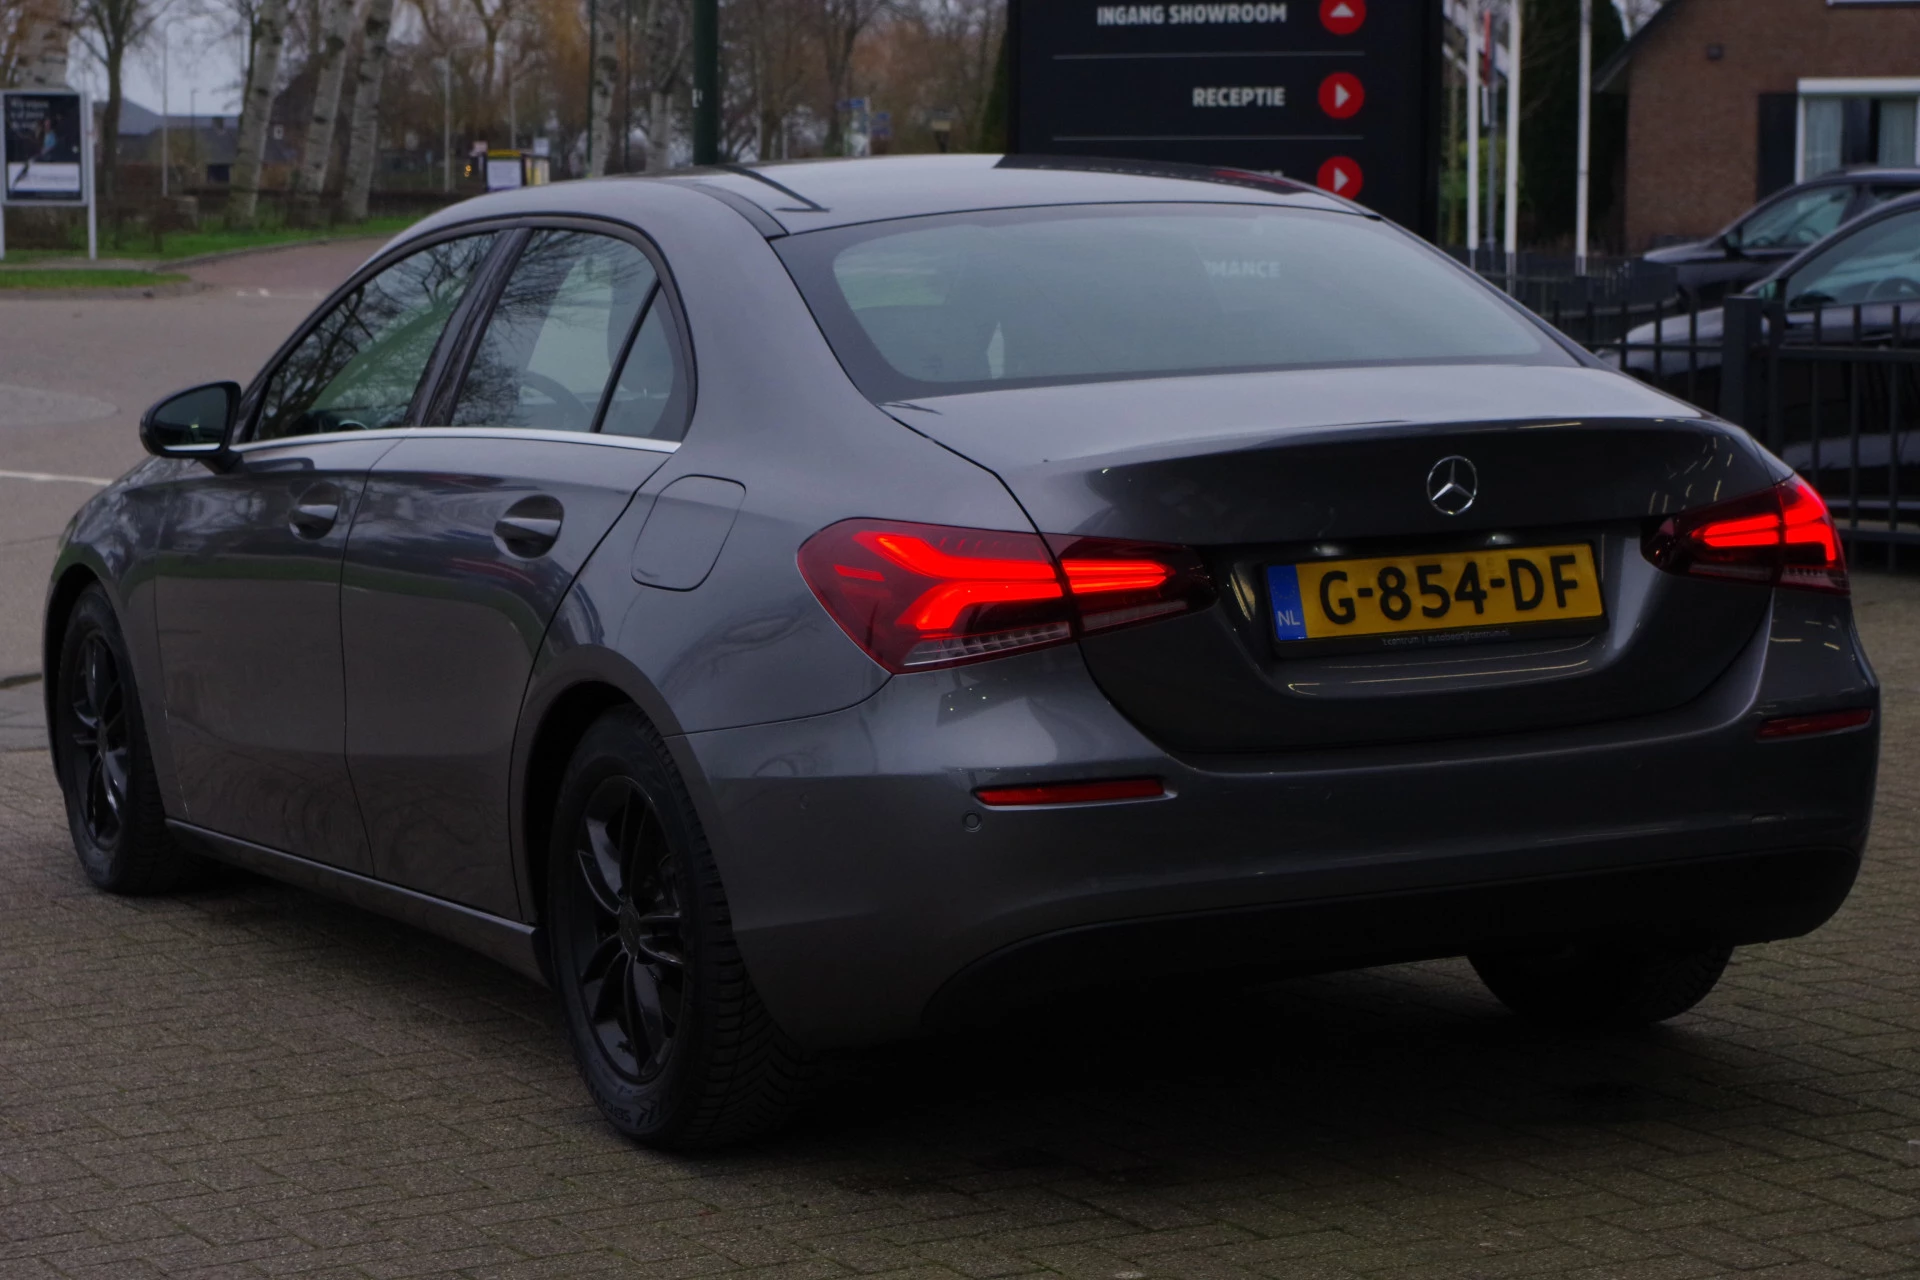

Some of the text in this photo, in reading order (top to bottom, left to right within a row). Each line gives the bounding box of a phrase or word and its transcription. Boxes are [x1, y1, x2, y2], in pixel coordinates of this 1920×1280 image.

[1096, 3, 1288, 26] INGANG SHOWROOM
[1192, 87, 1286, 108] RECEPTIE
[1319, 554, 1579, 626] G-854-DF
[1276, 609, 1301, 626] NL
